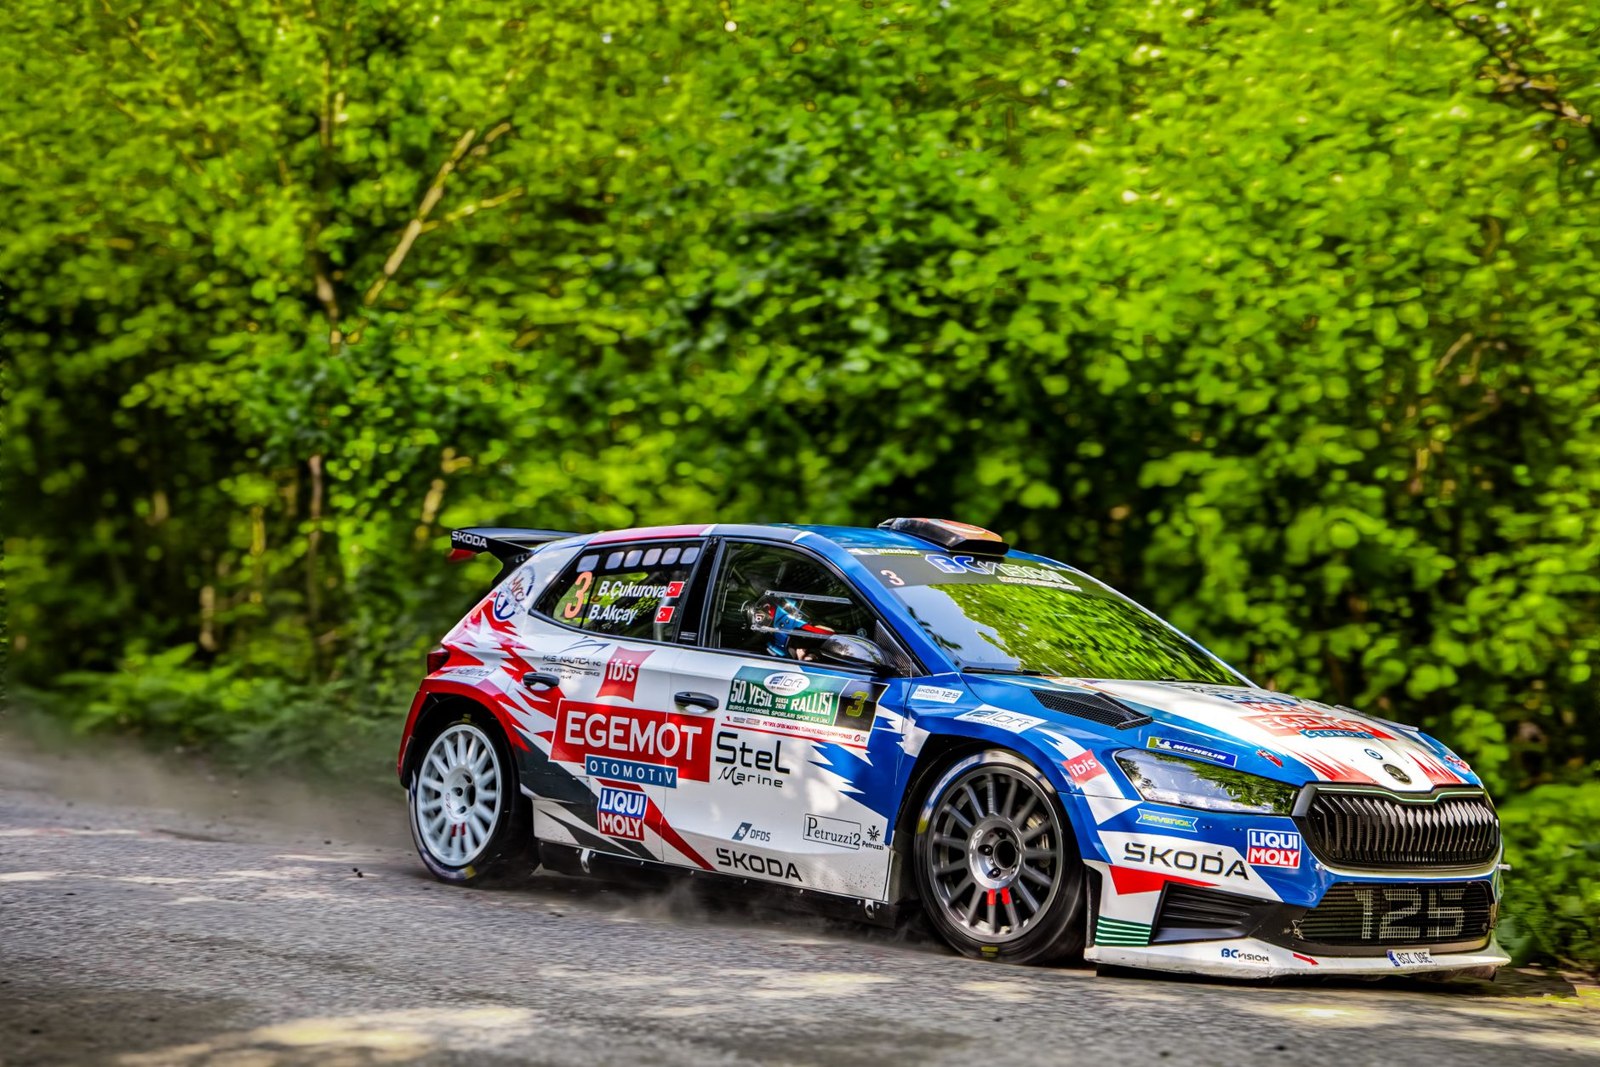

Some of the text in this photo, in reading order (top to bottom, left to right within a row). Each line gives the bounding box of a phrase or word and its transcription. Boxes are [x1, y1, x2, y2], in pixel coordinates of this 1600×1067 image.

[881, 569, 905, 586] 3
[564, 571, 593, 619] 3
[598, 580, 667, 600] B.Çukurova
[588, 604, 638, 625] B.Akçay
[607, 657, 637, 683] ibis
[730, 679, 747, 704] 50.
[846, 690, 869, 718] 3
[564, 710, 703, 761] EGEMOT
[1173, 744, 1227, 761] MICHELIN
[718, 766, 784, 788] Marine
[1071, 757, 1097, 778] ibis
[601, 789, 645, 815] LIQUI
[601, 813, 642, 838] MOLY
[749, 828, 771, 842] DFDS
[862, 840, 884, 850] Petruzzi
[1251, 832, 1299, 850] LIQUI
[1250, 849, 1300, 868] MOLY
[1354, 888, 1466, 940] 125
